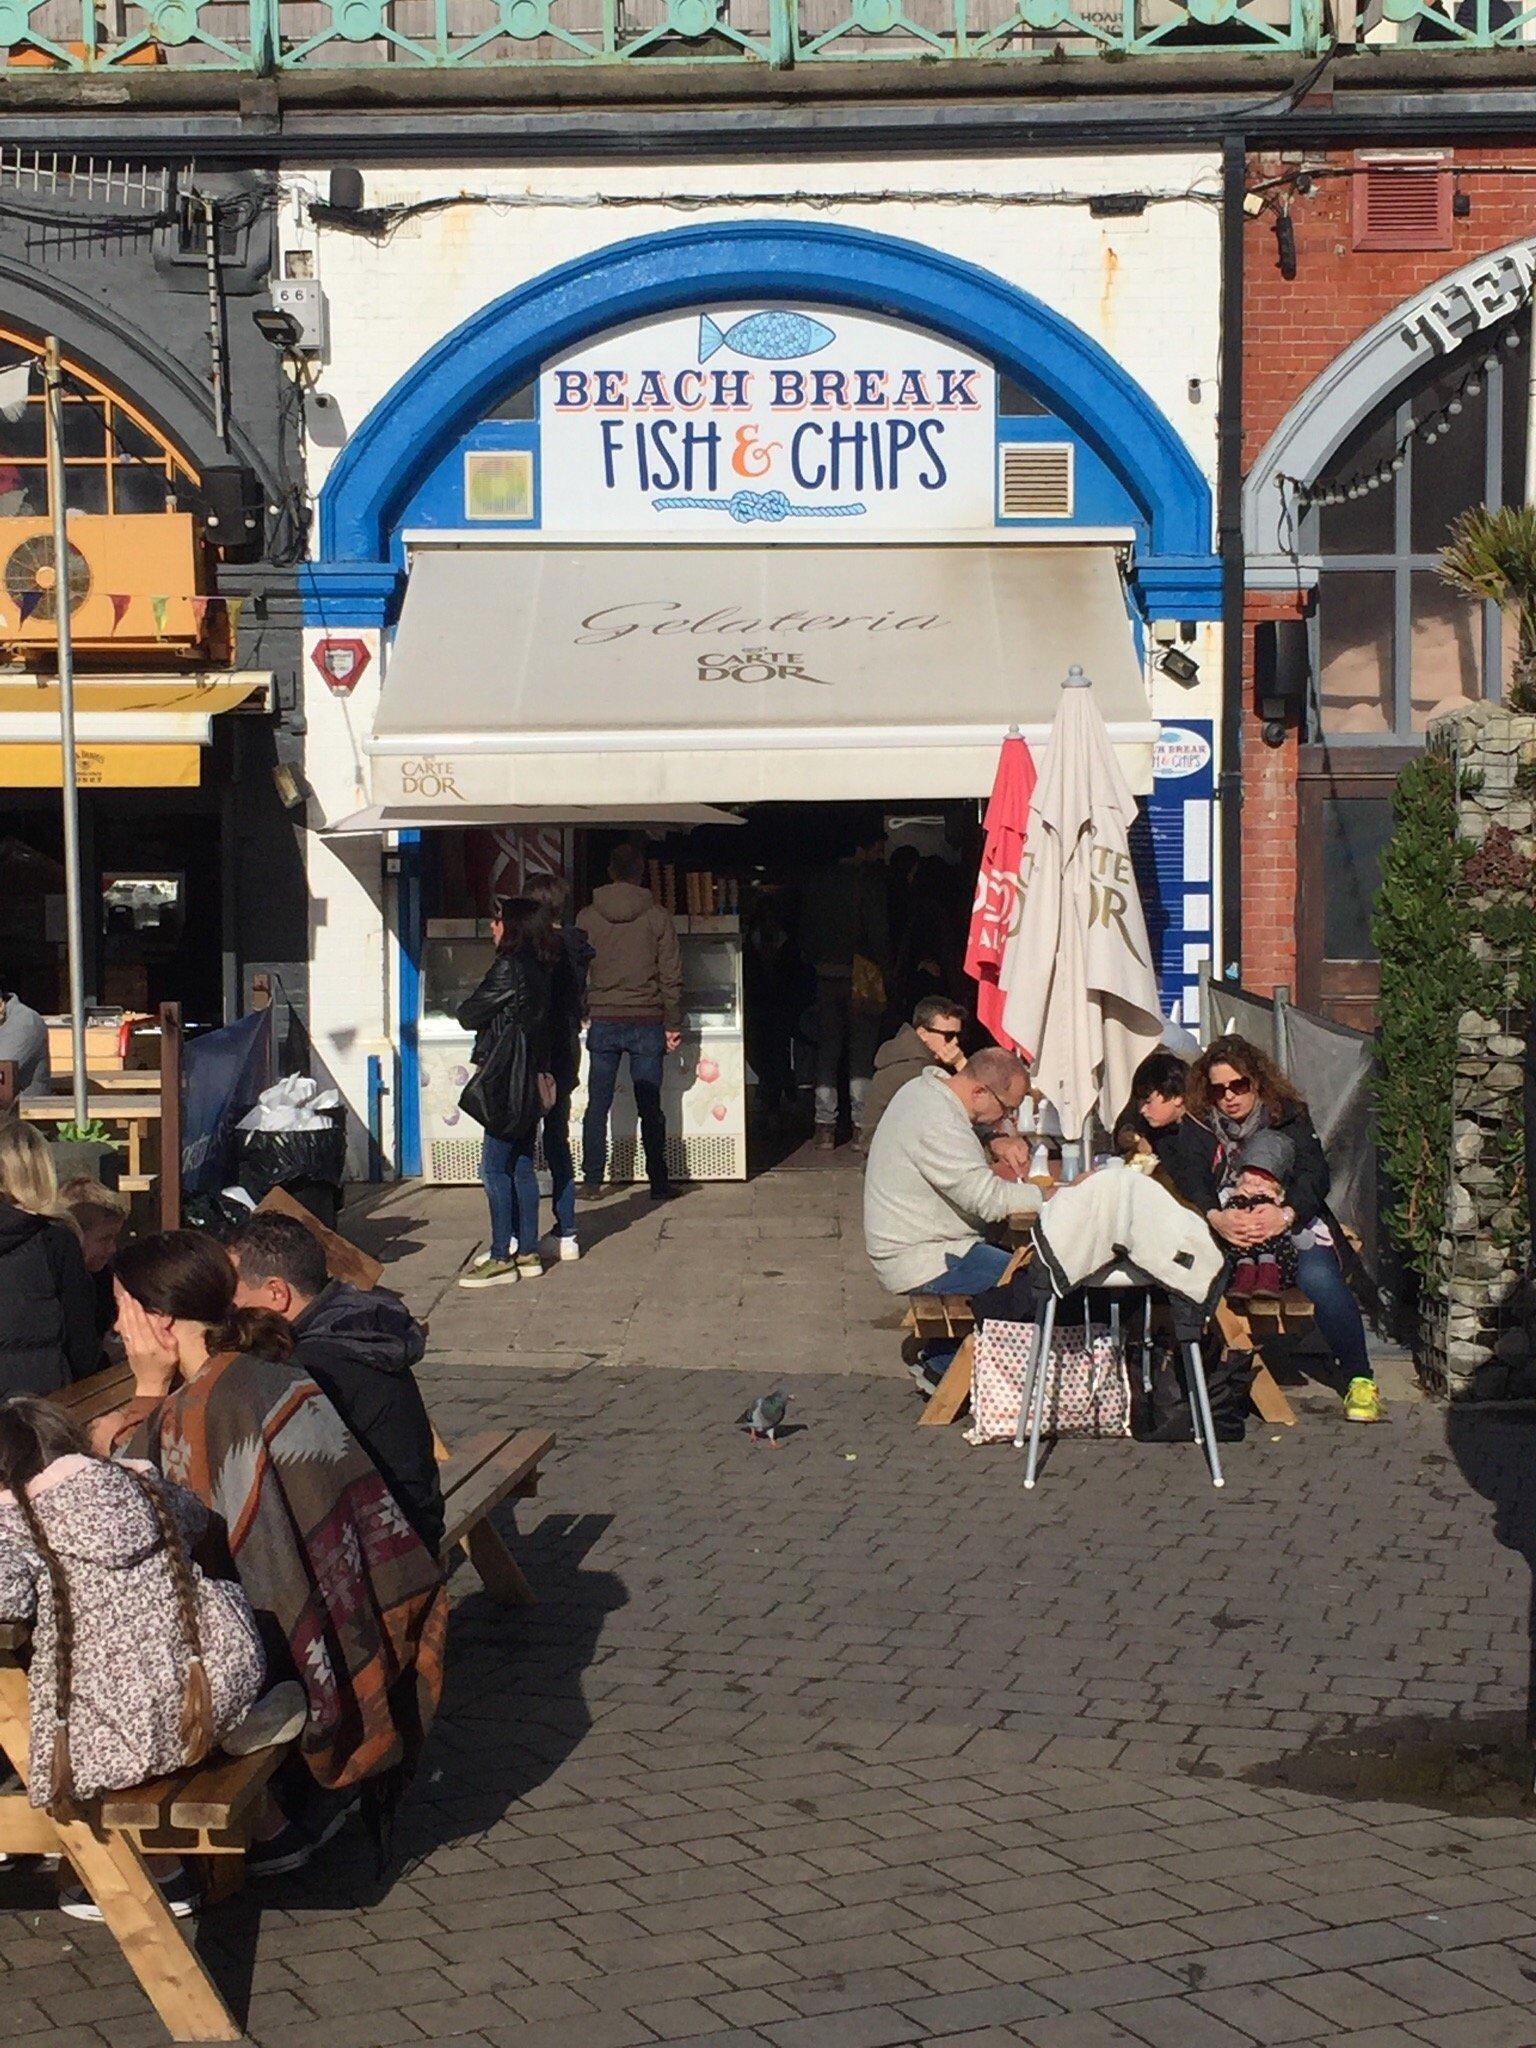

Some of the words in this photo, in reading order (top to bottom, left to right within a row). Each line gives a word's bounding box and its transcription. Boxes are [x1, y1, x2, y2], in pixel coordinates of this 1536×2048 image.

[554, 370, 752, 409] BEACH
[770, 369, 980, 410] BREAK
[600, 419, 722, 492] FISH
[731, 424, 784, 478] &
[791, 419, 947, 491] CHIPS
[574, 601, 951, 645] Gelateria
[697, 653, 805, 667] CARTE
[401, 760, 455, 777] CARTE
